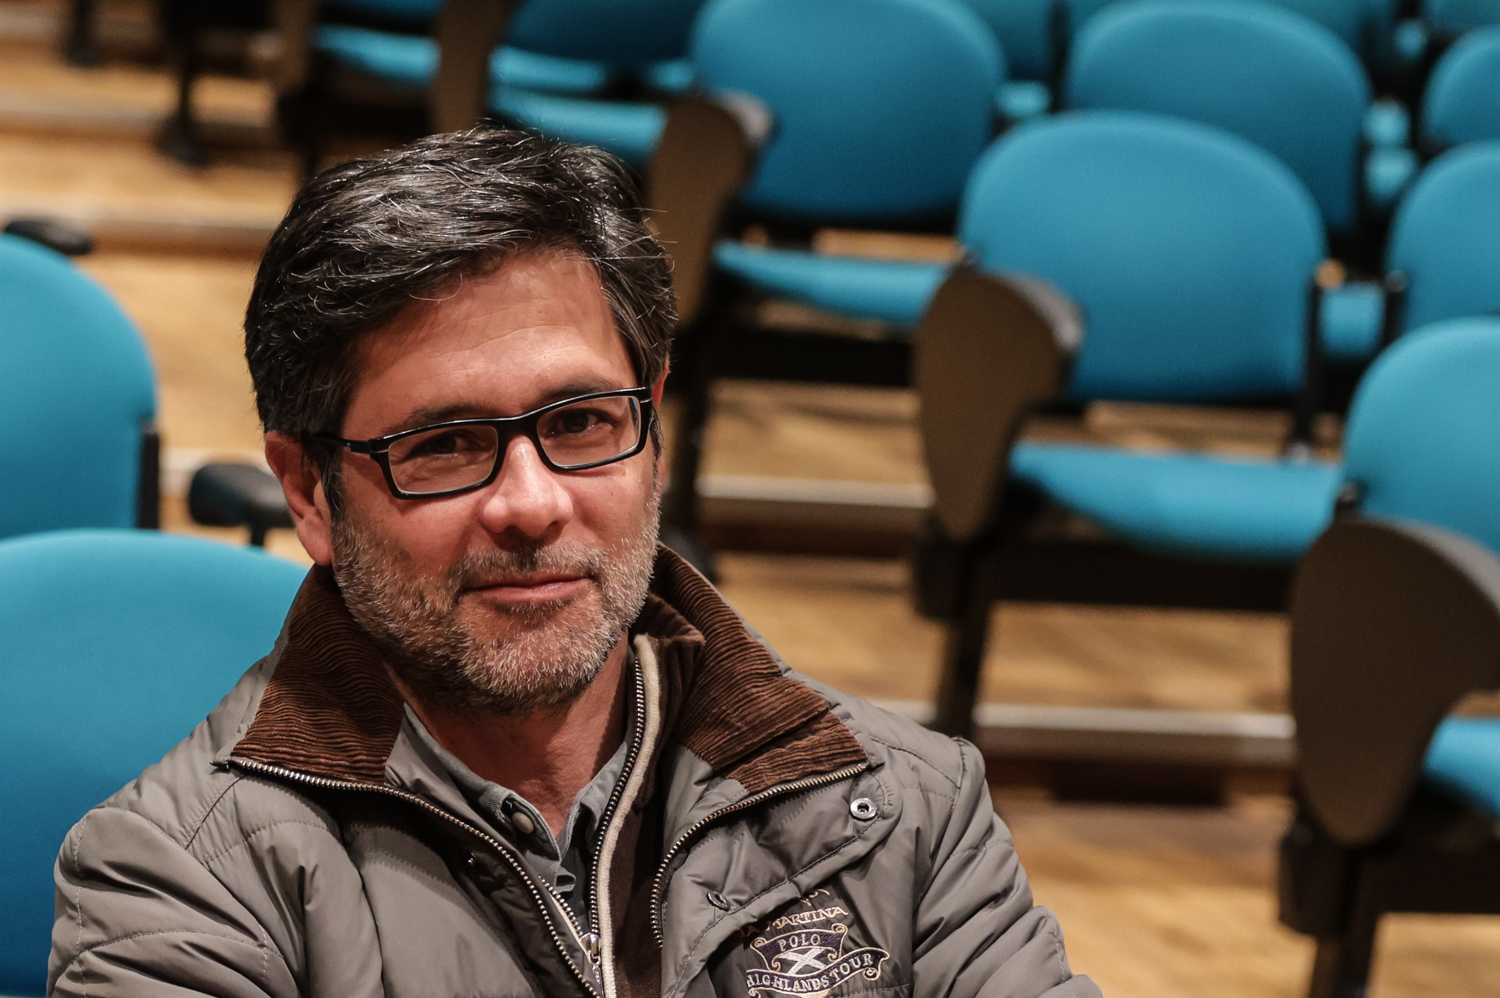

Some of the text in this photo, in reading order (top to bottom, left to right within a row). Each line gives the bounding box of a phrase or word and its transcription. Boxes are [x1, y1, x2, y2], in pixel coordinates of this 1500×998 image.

[777, 934, 821, 951] POLO
[746, 953, 874, 993] HIGHLANDS TOUR
